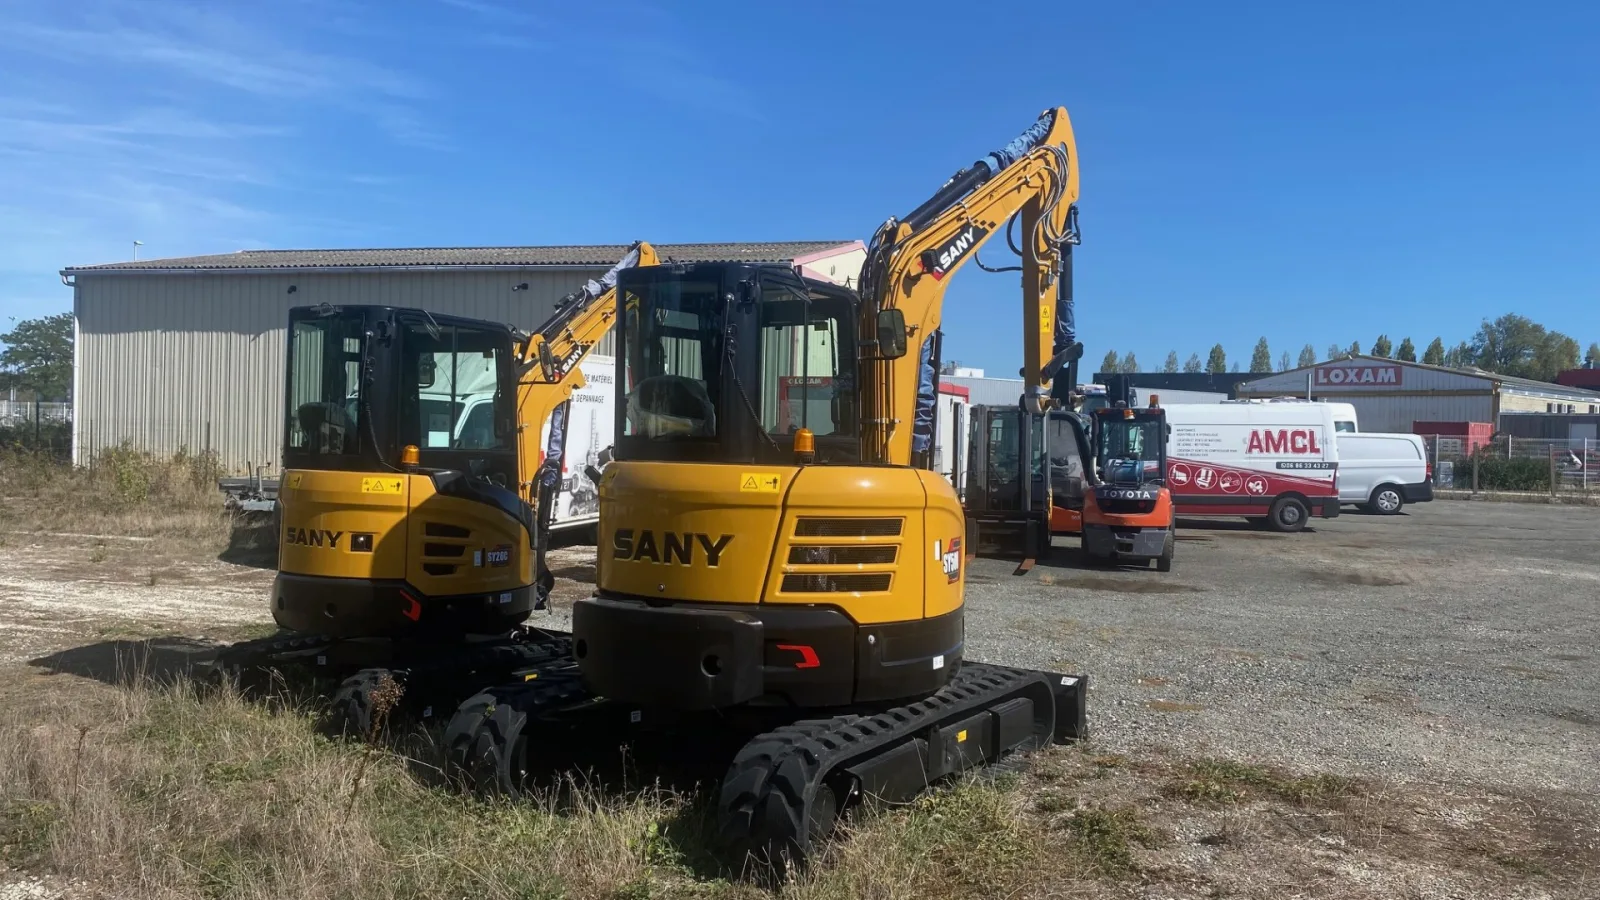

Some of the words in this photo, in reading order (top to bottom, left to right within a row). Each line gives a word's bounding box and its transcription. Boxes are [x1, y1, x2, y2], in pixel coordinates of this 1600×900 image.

[940, 226, 975, 270] SANY
[562, 345, 583, 373] SANY
[1317, 367, 1397, 384] LOXAM
[1246, 429, 1321, 455] AMCL
[1103, 489, 1151, 499] TOYOTA
[286, 526, 344, 550] SANY
[613, 527, 735, 569] SANY
